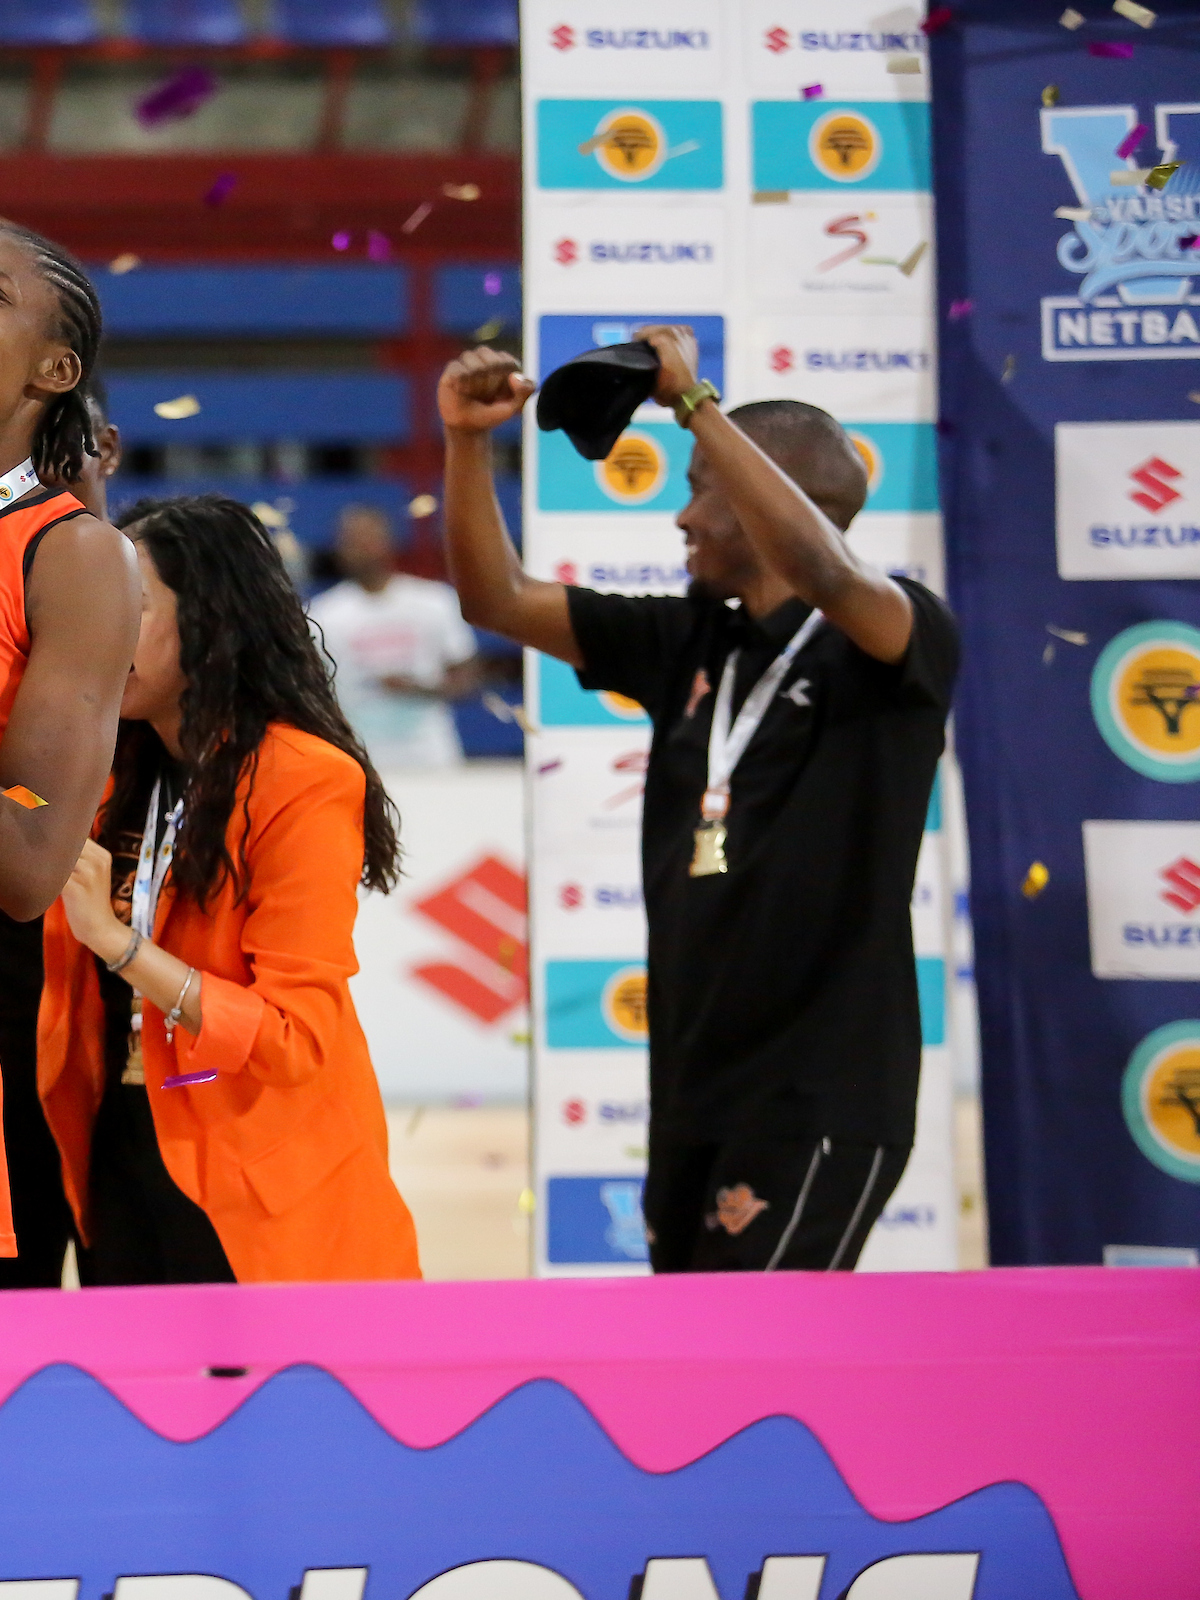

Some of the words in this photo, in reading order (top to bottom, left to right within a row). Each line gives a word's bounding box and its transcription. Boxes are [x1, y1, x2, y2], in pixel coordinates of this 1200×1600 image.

[586, 29, 711, 50] SUZUKI
[801, 29, 927, 52] SUZUKI
[1107, 194, 1200, 222] VARSI
[590, 243, 714, 263] SUZUKI
[1058, 311, 1200, 346] NETBA
[805, 349, 930, 372] SUZUKI
[1088, 525, 1200, 548] SUZUK
[590, 565, 690, 585] SUZU
